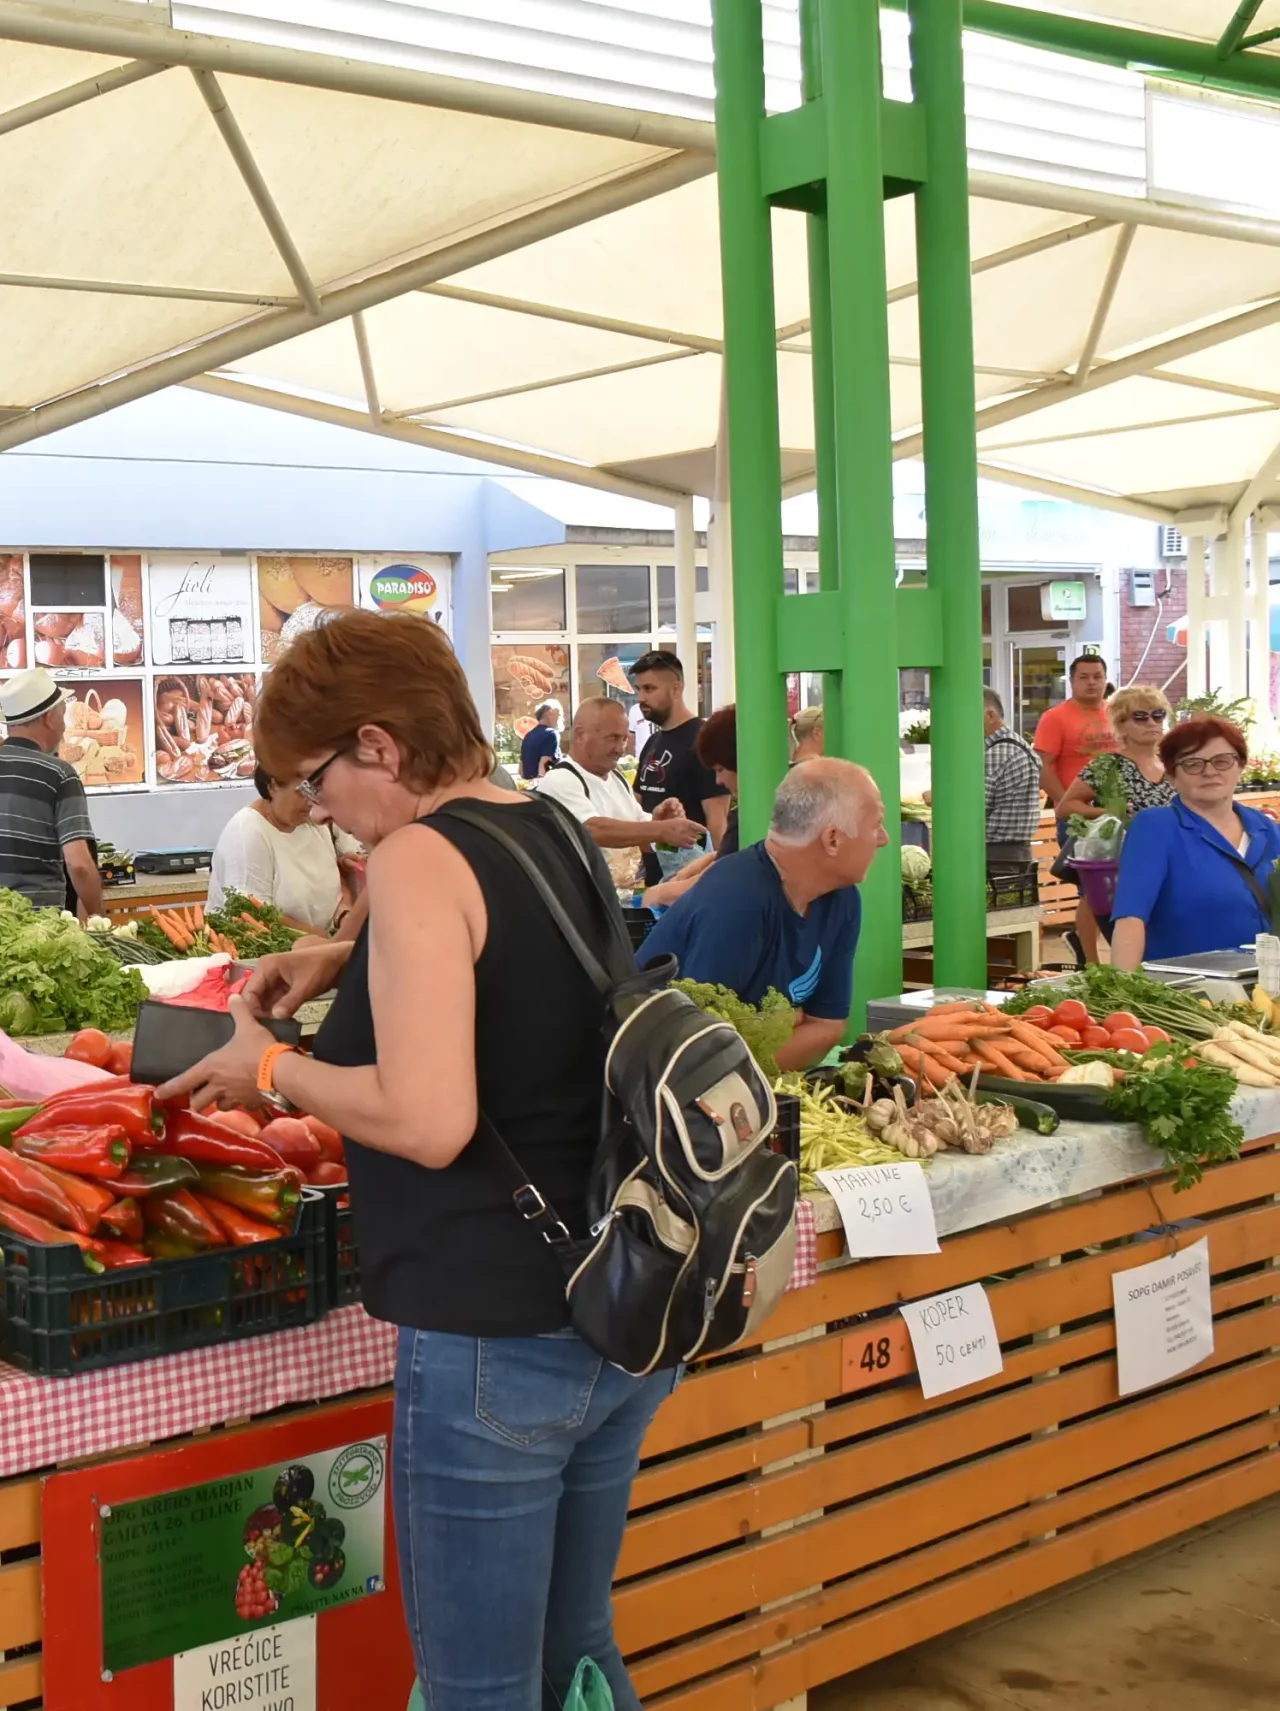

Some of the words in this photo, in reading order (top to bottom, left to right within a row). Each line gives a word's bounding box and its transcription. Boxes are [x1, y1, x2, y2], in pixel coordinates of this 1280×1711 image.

[376, 581, 432, 595] PARADISO
[858, 1196, 893, 1223] 2,50
[898, 1194, 913, 1214] €
[919, 1295, 969, 1334] KOPER
[859, 1337, 892, 1373] 48
[935, 1344, 955, 1367] 50
[195, 1476, 254, 1504] MARJAN
[209, 1633, 283, 1677] VREĆICE
[201, 1664, 290, 1711] KORISTITE
